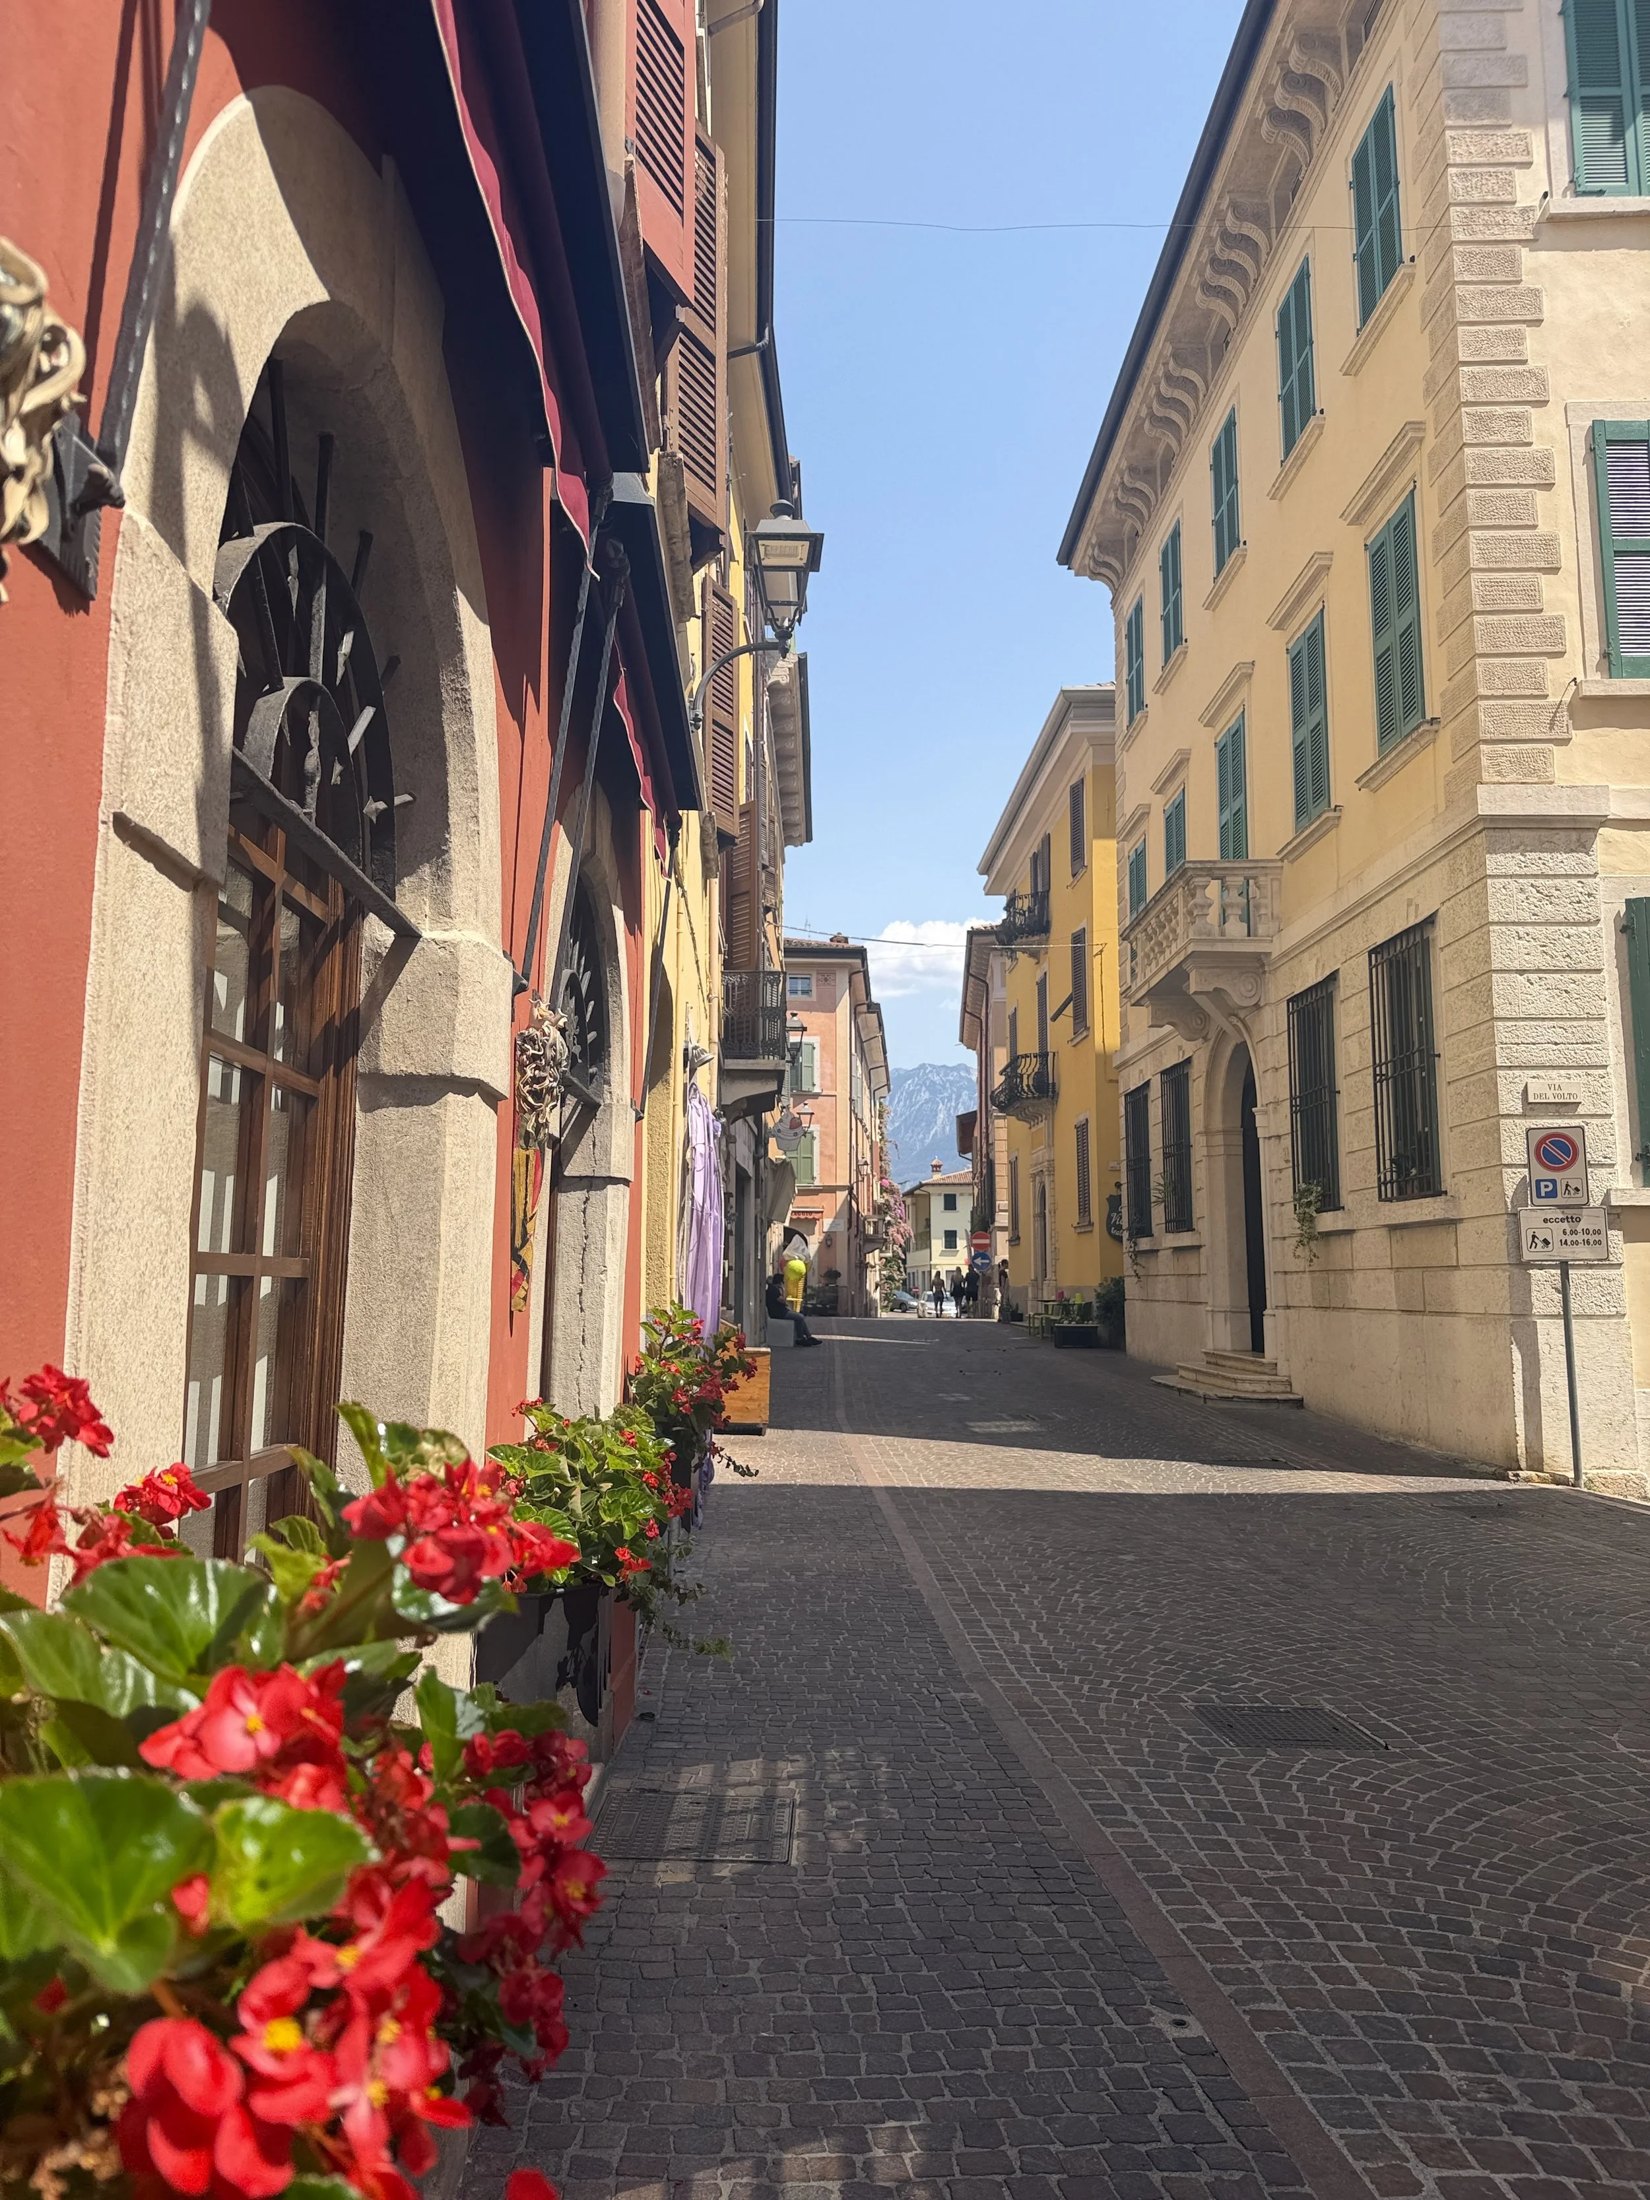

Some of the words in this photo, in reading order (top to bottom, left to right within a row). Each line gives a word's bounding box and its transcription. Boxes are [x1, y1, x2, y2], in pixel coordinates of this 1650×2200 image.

[1547, 1083, 1562, 1091] VIA
[1533, 1092, 1550, 1100] DEL
[1552, 1092, 1578, 1100] VOLTO
[1540, 1181, 1553, 1197] P
[1542, 1215, 1582, 1224] eccetto
